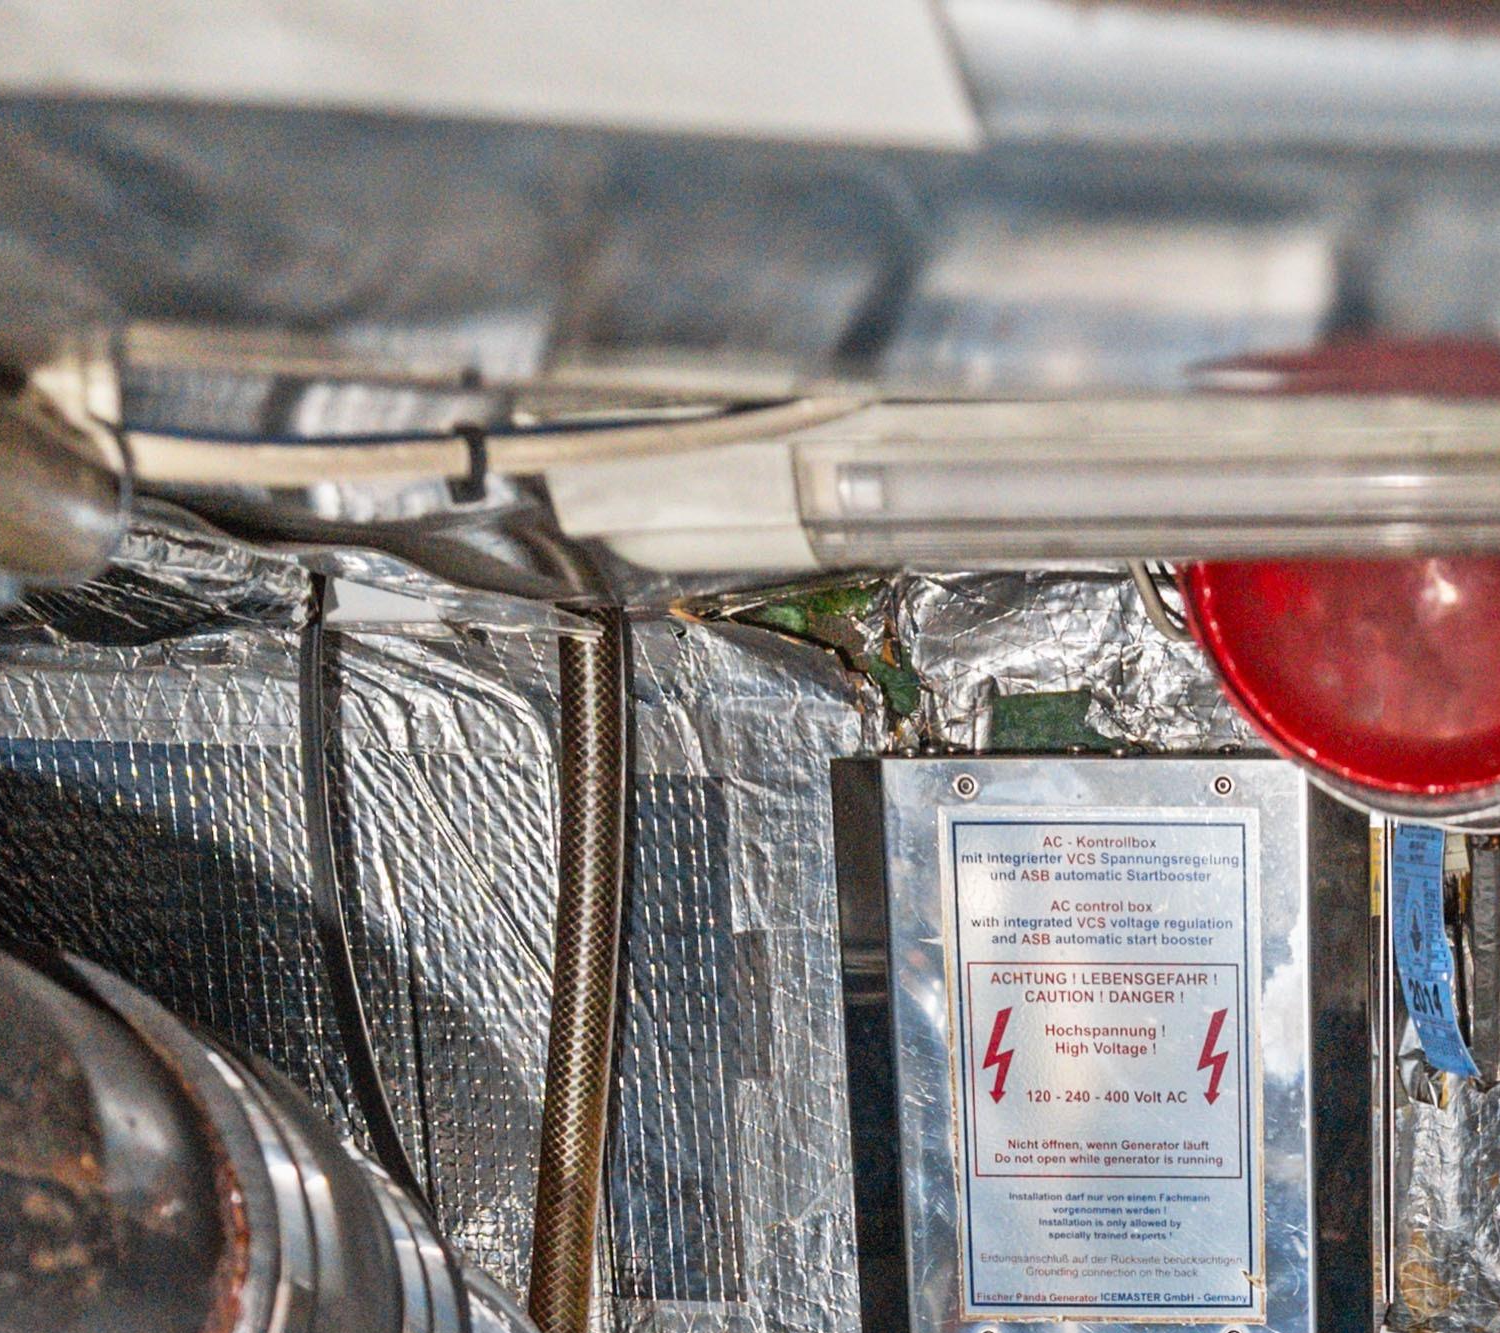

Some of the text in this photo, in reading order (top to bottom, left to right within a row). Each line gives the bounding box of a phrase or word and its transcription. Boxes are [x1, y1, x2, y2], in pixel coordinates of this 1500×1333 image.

[1043, 836, 1062, 848] AC
[1077, 836, 1156, 848] Kontrollbox
[962, 853, 1239, 867] mit integrierter VCS Spannungsregelung
[990, 870, 1211, 882] und ASB automatic Startbooster
[1051, 900, 1152, 912] AC control box
[972, 917, 1233, 931] with integrated VCS voltage regulation
[992, 934, 1213, 945] and ASB automatic start booster
[991, 972, 1067, 985] ACHTUNG
[1082, 973, 1208, 985] LEBENSGEFAHR
[1025, 991, 1094, 1003] CAUTION
[1110, 991, 1174, 1003] DANGER
[1408, 978, 1445, 1018] 2014
[1045, 1024, 1156, 1040] Hochspannung
[1055, 1042, 1088, 1057] High
[1095, 1042, 1147, 1057] Voltage
[1027, 1091, 1050, 1102] 120
[1066, 1091, 1090, 1102] 240
[1106, 1091, 1130, 1103] 400
[1134, 1091, 1161, 1103] Volt
[1166, 1092, 1187, 1103] AC
[1008, 1140, 1039, 1150] Nicht
[1086, 1142, 1118, 1151] wenn
[1121, 1140, 1179, 1151] Generator
[995, 1153, 1223, 1167] Do not open while generator is running
[1009, 1193, 1062, 1202] Installation
[1065, 1193, 1084, 1202] darf
[1127, 1194, 1156, 1202] einem
[1160, 1194, 1210, 1203] Fachmann
[1053, 1207, 1122, 1216] vorgenommen
[1126, 1206, 1160, 1215] werden
[1039, 1219, 1181, 1229] Installation is only allowed by
[1049, 1232, 1091, 1241] specially
[1094, 1232, 1127, 1240] trained
[1130, 1233, 1166, 1241] experts
[1072, 1254, 1088, 1264] auf
[1091, 1255, 1108, 1264] der
[1026, 1267, 1197, 1279] Grounding connection on the back
[977, 1292, 1013, 1301] Fischer
[1016, 1293, 1046, 1302] Panda
[1050, 1293, 1098, 1302] Generator
[1101, 1293, 1160, 1302] ICEMASTER
[1163, 1293, 1194, 1302] GmbH
[1204, 1294, 1247, 1305] Germany
